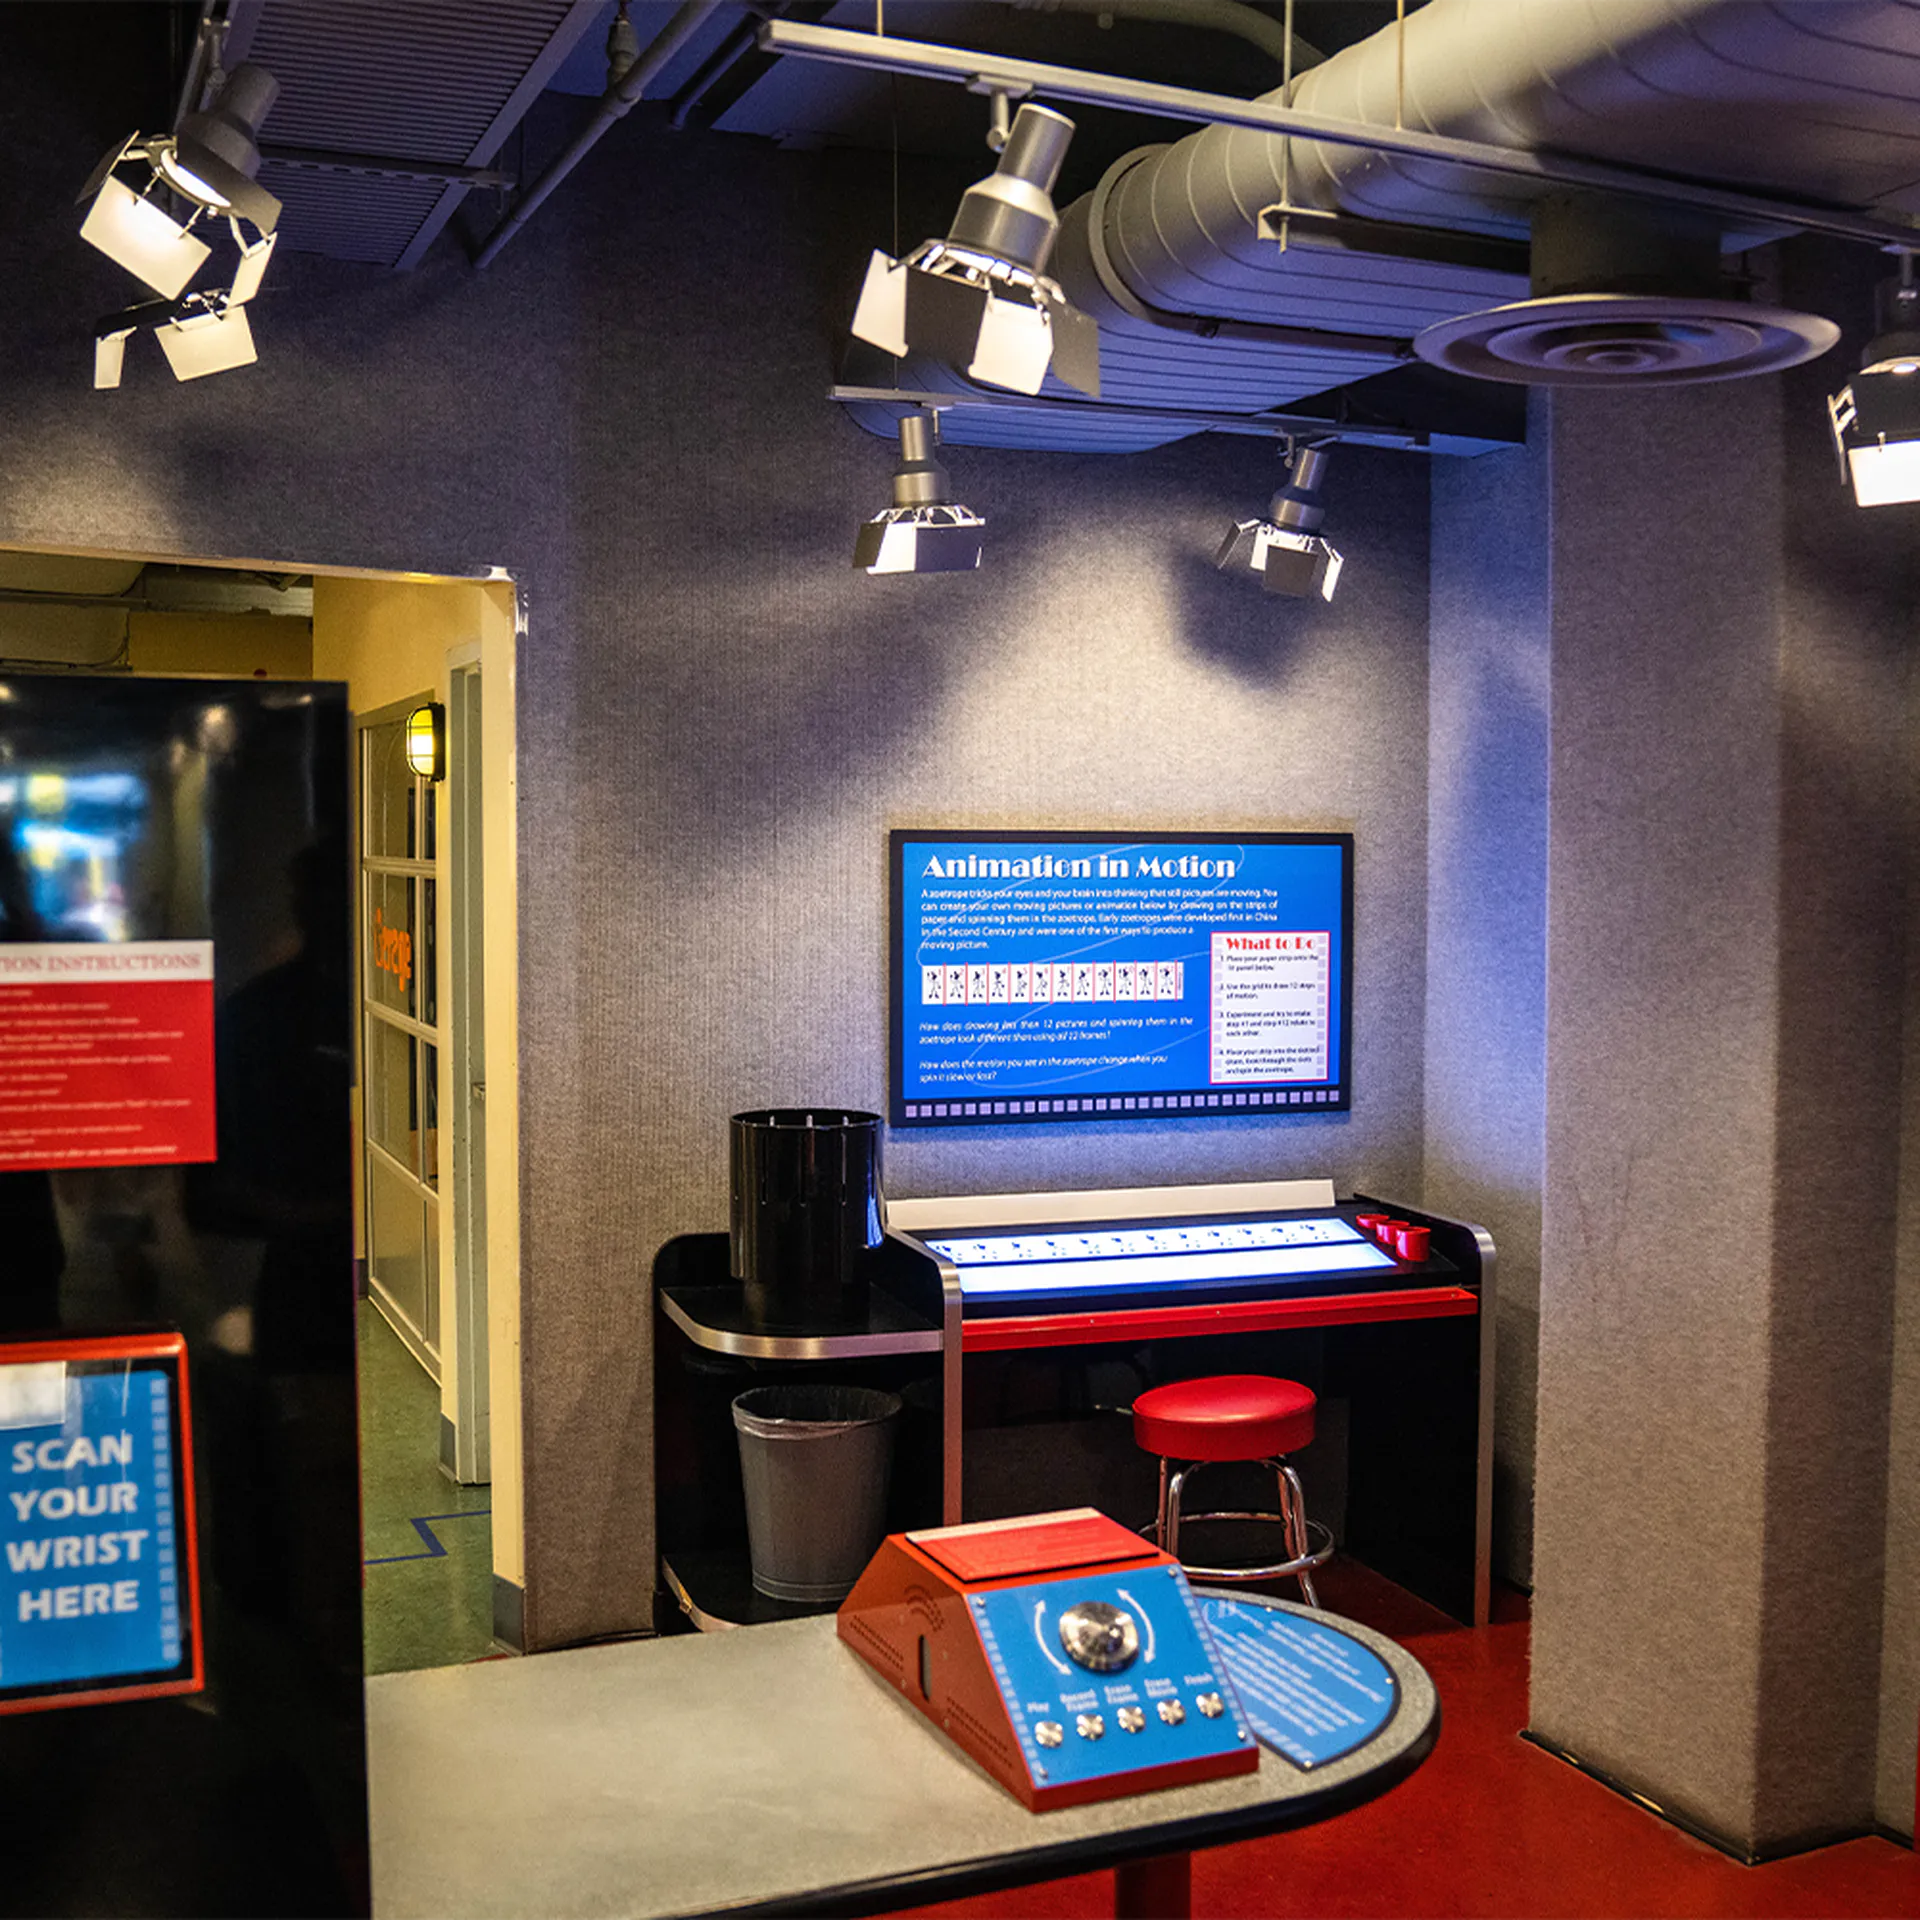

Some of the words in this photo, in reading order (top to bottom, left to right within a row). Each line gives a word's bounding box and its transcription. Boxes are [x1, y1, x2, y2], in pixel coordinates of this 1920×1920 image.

[922, 854, 1091, 878] Animation
[1099, 855, 1119, 878] in
[1136, 855, 1235, 878] Motion
[921, 889, 928, 898] A
[929, 890, 968, 900] zoetrope
[969, 889, 993, 899] tricks
[994, 890, 1012, 900] your
[1014, 890, 1034, 900] eyes
[1035, 888, 1052, 898] and
[1053, 889, 1071, 900] your
[1072, 888, 1095, 898] brain
[1095, 888, 1112, 898] into
[1113, 888, 1148, 899] thinking
[1149, 888, 1166, 897] that
[1167, 888, 1180, 897] still
[1182, 889, 1214, 899] pictures
[1216, 889, 1229, 897] are
[1263, 888, 1278, 897] You
[921, 903, 938, 911] can
[940, 902, 966, 911] create
[968, 902, 990, 912] your
[991, 902, 1011, 911] own
[1013, 901, 1046, 912] moving
[1047, 901, 1082, 912] pictures
[1084, 902, 1093, 911] or
[1096, 901, 1137, 911] animation
[1140, 900, 1166, 910] below
[1168, 900, 1178, 912] by
[1180, 900, 1214, 911] drawing
[1216, 902, 1228, 910] on
[1229, 900, 1243, 910] the
[1245, 901, 1267, 911] strips
[1268, 900, 1278, 909] of
[921, 915, 947, 925] paper
[948, 914, 966, 924] and
[968, 914, 1005, 925] spinning
[1007, 913, 1029, 923] them
[1031, 914, 1040, 923] in
[1041, 914, 1057, 923] the
[1098, 912, 1118, 924] Early
[1121, 914, 1161, 923] zoetropes
[1162, 914, 1182, 922] were
[1184, 912, 1227, 923] developed
[1228, 912, 1243, 921] first
[1245, 913, 1253, 921] in
[1255, 912, 1278, 921] China
[931, 927, 947, 937] the
[948, 926, 980, 937] Second
[982, 926, 1016, 938] Century
[1017, 926, 1035, 936] and
[1036, 928, 1057, 936] were
[1058, 927, 1075, 936] one
[1076, 926, 1086, 936] of
[1086, 926, 1101, 936] the
[1103, 926, 1119, 935] first
[1120, 928, 1141, 937] ways
[1141, 926, 1151, 935] to
[1153, 926, 1187, 936] produce
[920, 941, 955, 951] moving
[956, 941, 990, 951] picture.
[1226, 937, 1270, 950] What
[1276, 937, 1291, 950] to
[1296, 937, 1315, 949] Do
[49, 954, 201, 971] INSTRUCTIONS
[919, 1023, 939, 1031] How
[941, 1021, 962, 1031] does
[964, 1021, 999, 1031] drawing
[1021, 1020, 1039, 1029] than
[1044, 1019, 1053, 1028] 12
[1055, 1020, 1088, 1030] pictures
[1090, 1018, 1107, 1027] and
[1109, 1018, 1143, 1028] spinning
[1146, 1017, 1167, 1026] them
[1180, 1017, 1193, 1025] the
[919, 1061, 939, 1069] How
[940, 1060, 960, 1069] does
[961, 1060, 976, 1068] the
[977, 1059, 1006, 1068] motion
[1006, 1059, 1023, 1070] you
[1024, 1059, 1037, 1068] see
[1048, 1057, 1062, 1066] the
[1062, 1057, 1097, 1066] zoetrope
[1098, 1056, 1128, 1065] change
[1128, 1054, 1150, 1063] when
[1151, 1056, 1168, 1065] you
[11, 1434, 133, 1474] SCAN
[9, 1481, 138, 1522] YOUR
[6, 1529, 149, 1573] WRIST
[18, 1580, 139, 1622] HERE
